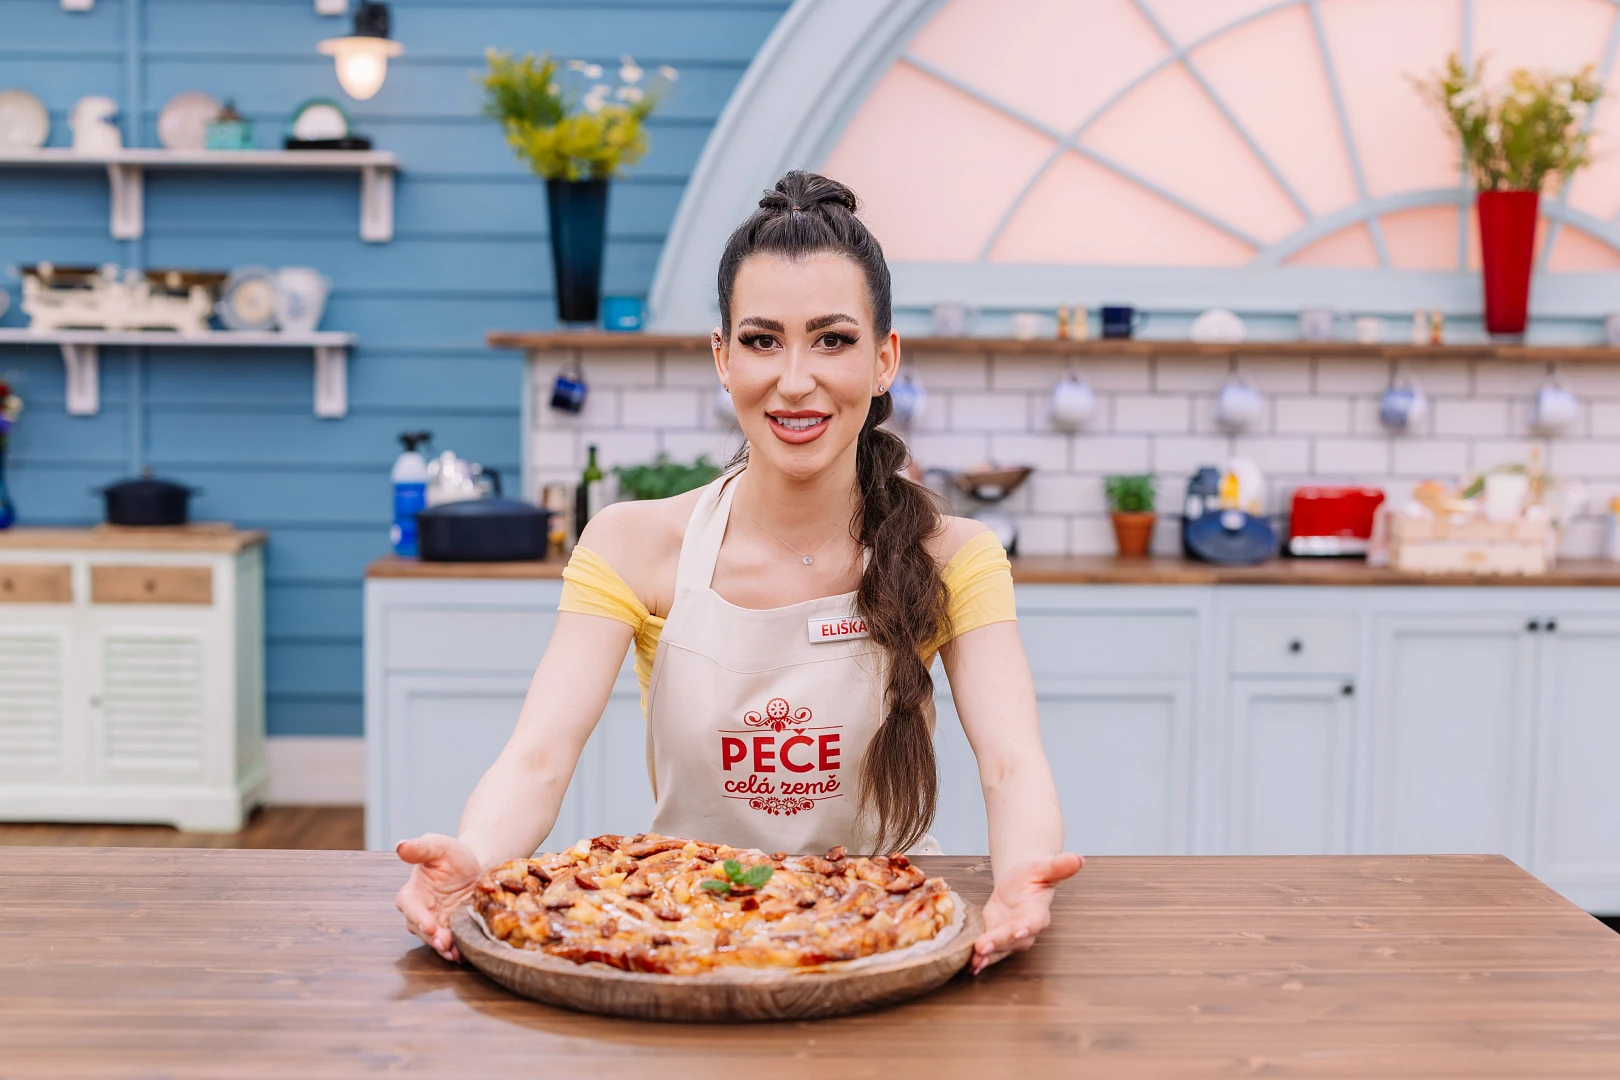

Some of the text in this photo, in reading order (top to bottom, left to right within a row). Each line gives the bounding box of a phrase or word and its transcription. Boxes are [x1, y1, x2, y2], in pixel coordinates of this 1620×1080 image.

[821, 619, 868, 637] ELIŠKA
[721, 728, 841, 773] PEČE
[724, 774, 841, 795] celá země
